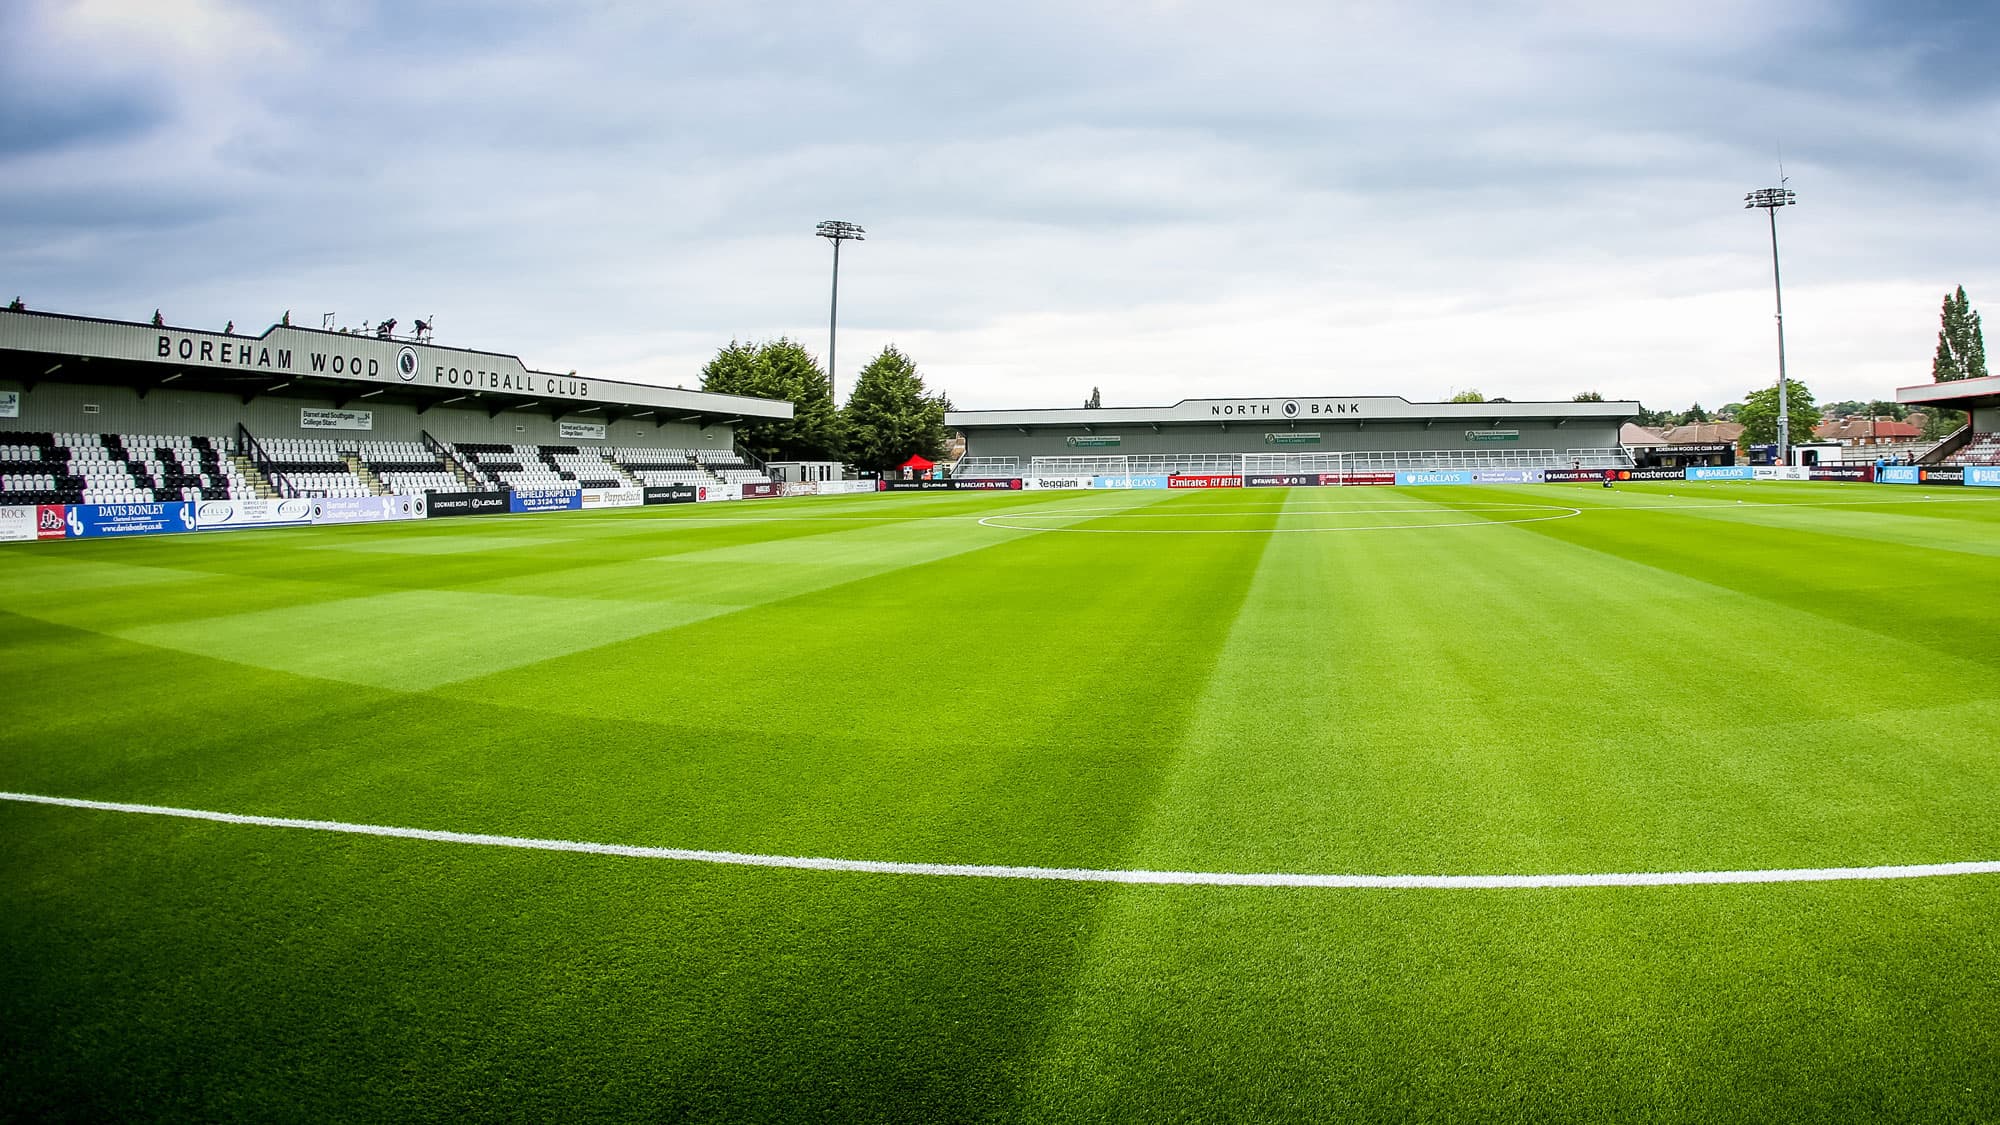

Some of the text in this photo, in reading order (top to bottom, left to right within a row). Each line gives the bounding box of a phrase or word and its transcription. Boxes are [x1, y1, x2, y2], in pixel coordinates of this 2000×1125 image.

[158, 335, 379, 377] BOREHAM WOOD
[435, 366, 588, 396] FOOTBALL CLUB
[1212, 403, 1360, 415] NORTH BANK
[303, 410, 320, 418] Barnet
[330, 412, 355, 420] Southgate
[1417, 474, 1460, 482] BARCLAYS
[1631, 469, 1685, 479] mastercard
[1706, 469, 1744, 477] BARCLAYS
[1885, 469, 1913, 480] BARCLAYS
[1926, 469, 1964, 481] mastercard
[1038, 478, 1078, 489] Reggiani
[1115, 479, 1157, 487] BARCLAYS
[1170, 478, 1208, 487] Emirates
[1210, 477, 1241, 487] FLY BETTER
[516, 489, 577, 499] ENFIELD SKIPS LTD
[604, 489, 641, 505] PappaRich
[98, 503, 164, 517] DAVIS BONLEY
